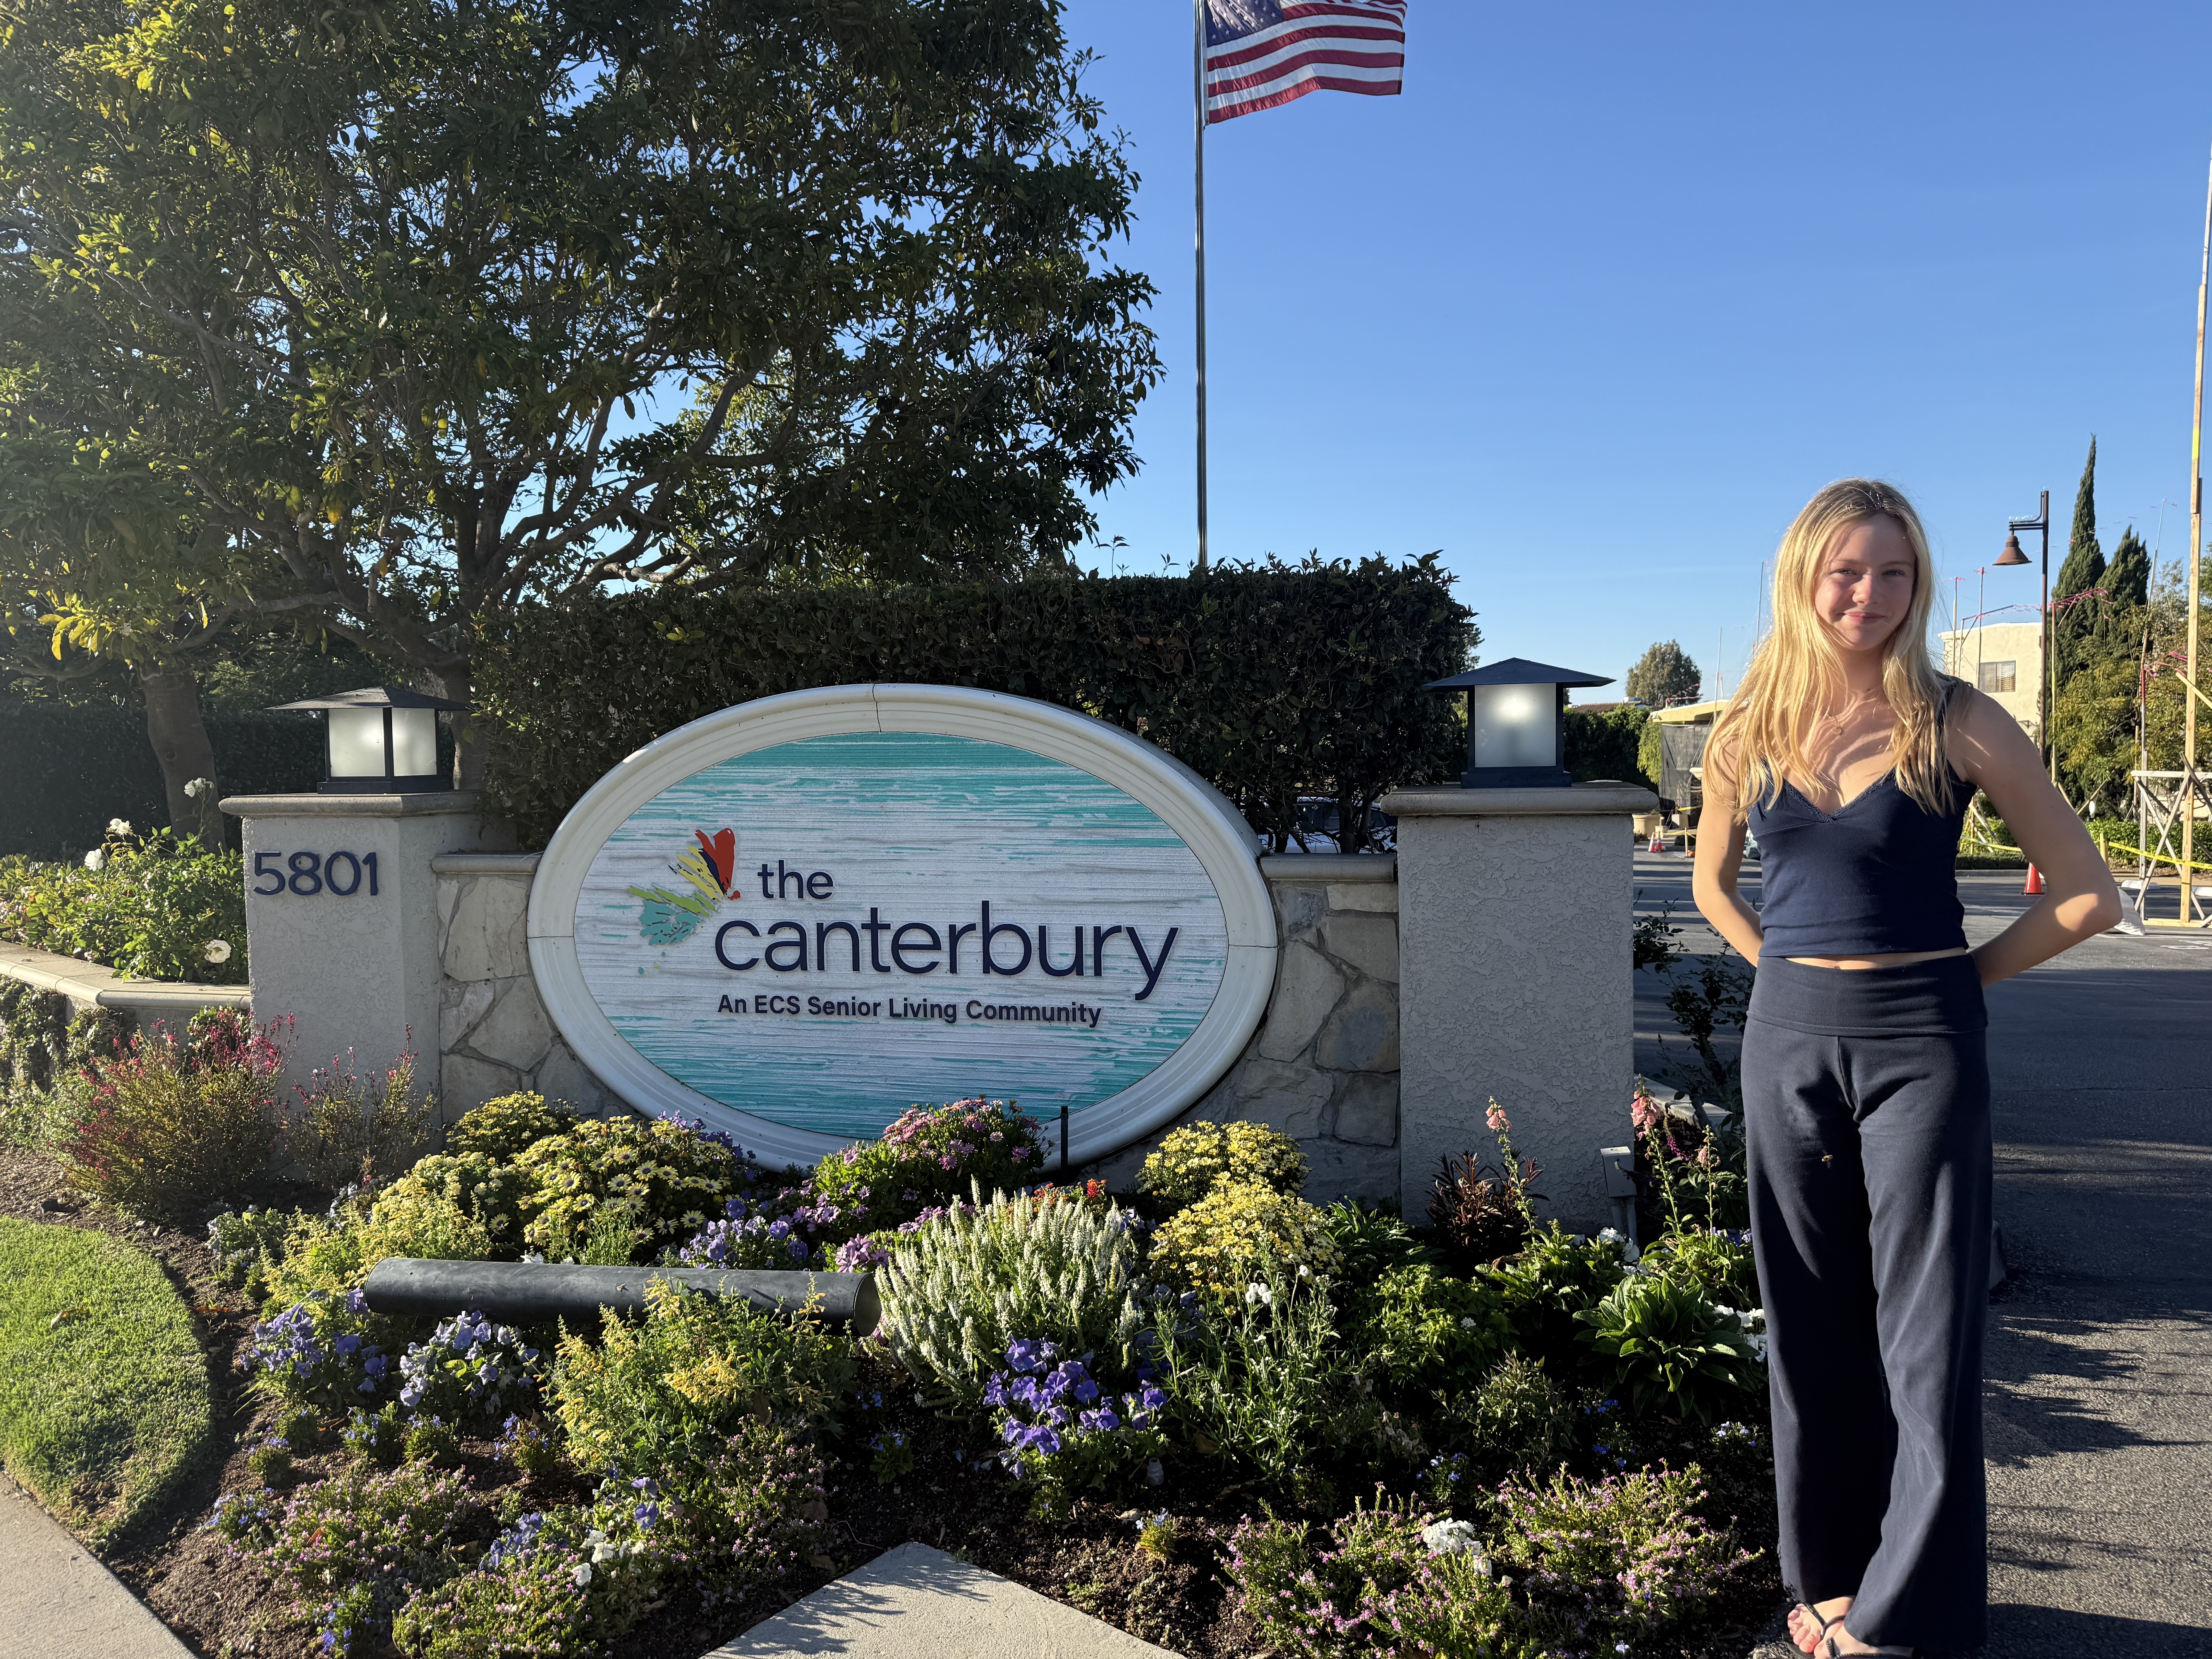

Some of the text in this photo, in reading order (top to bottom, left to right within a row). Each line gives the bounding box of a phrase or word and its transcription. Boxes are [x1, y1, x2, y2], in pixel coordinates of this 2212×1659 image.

[253, 850, 381, 899] 5801
[757, 859, 834, 900] the
[714, 900, 1179, 1001] canterbury
[717, 994, 1102, 1029] An ECS Senior Living Community
